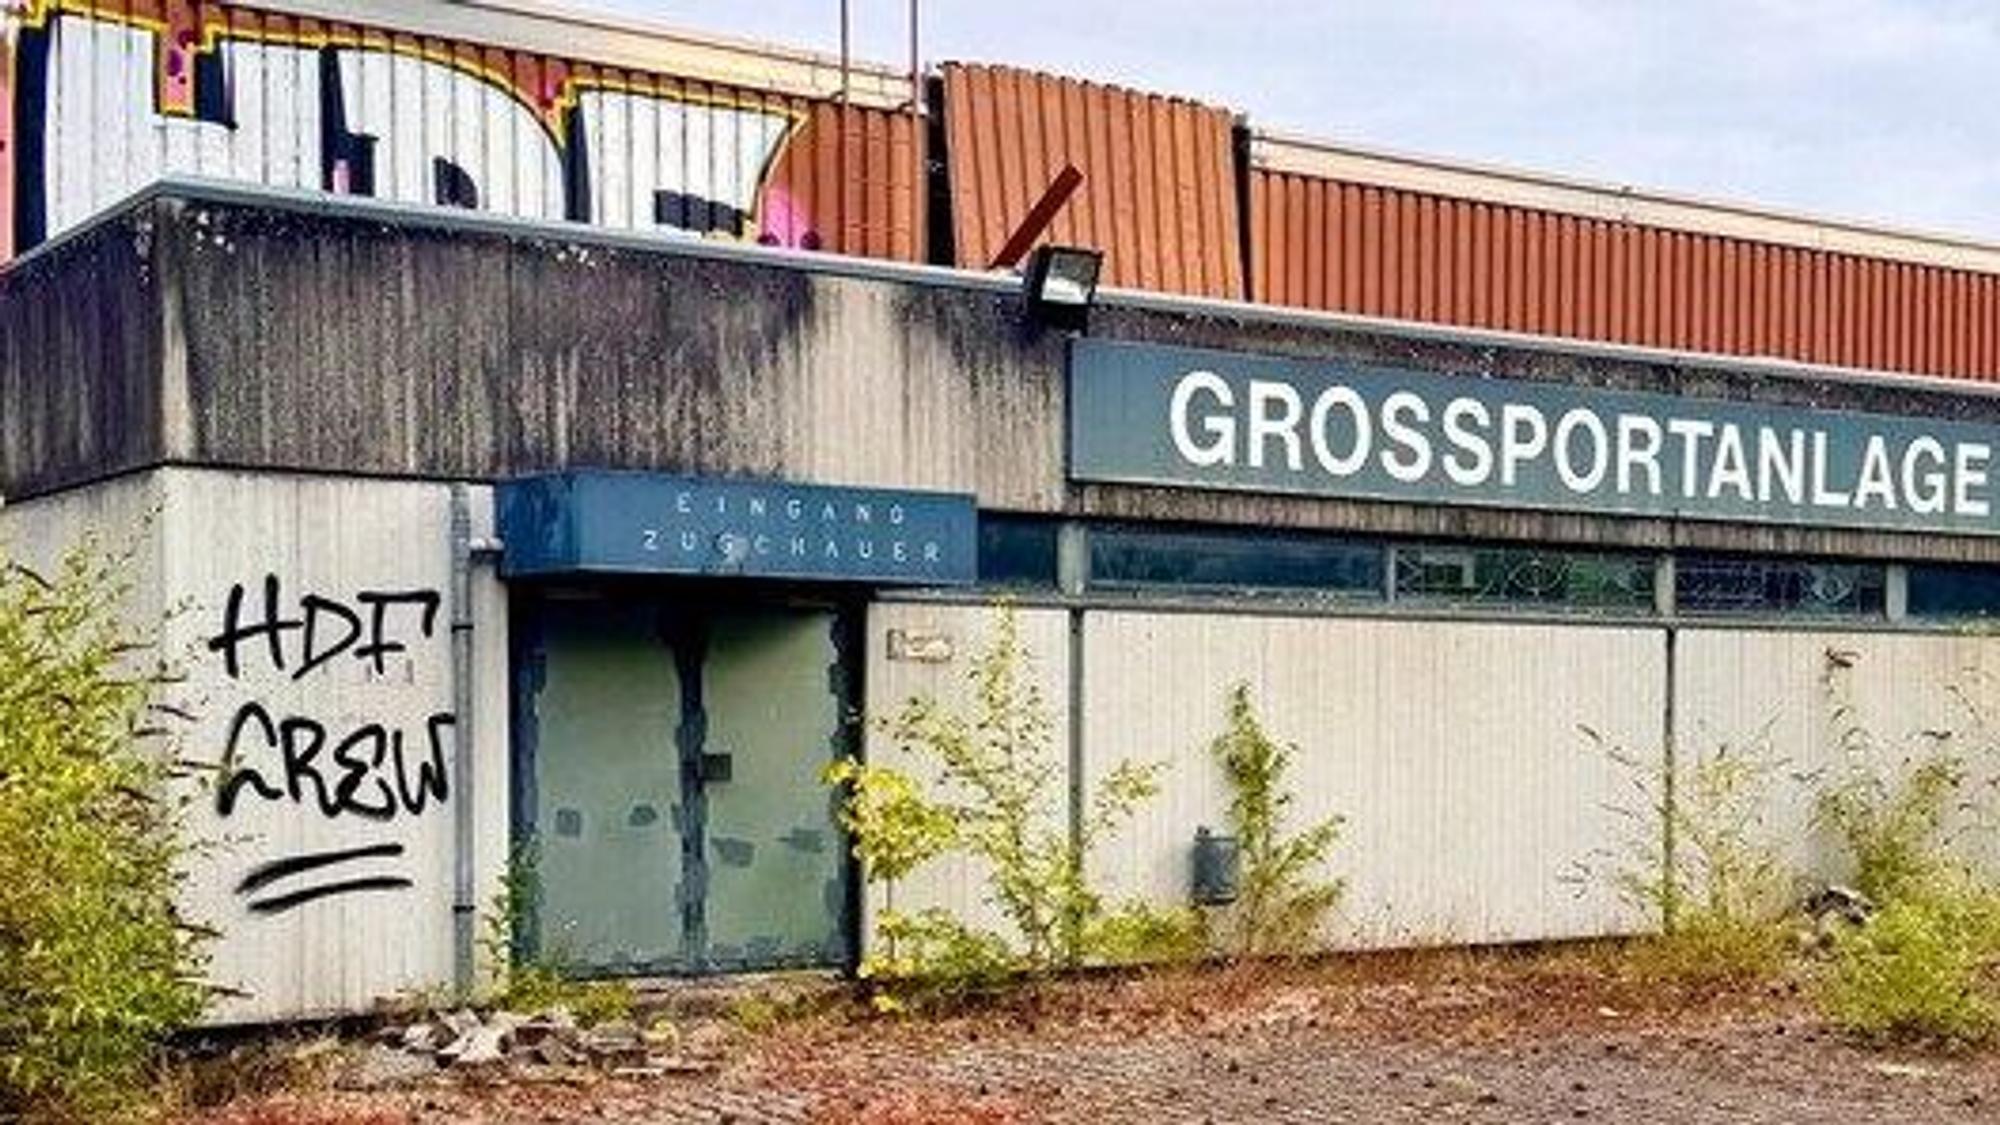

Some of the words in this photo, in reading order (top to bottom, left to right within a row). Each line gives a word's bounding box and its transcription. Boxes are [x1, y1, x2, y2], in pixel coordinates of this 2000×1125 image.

[1168, 369, 1992, 517] GROSSPORTANLAGE
[643, 529, 941, 563] ZUSCHAUER
[676, 492, 904, 525] EINGANG
[208, 573, 441, 681] HDF
[216, 701, 455, 819] CREW
